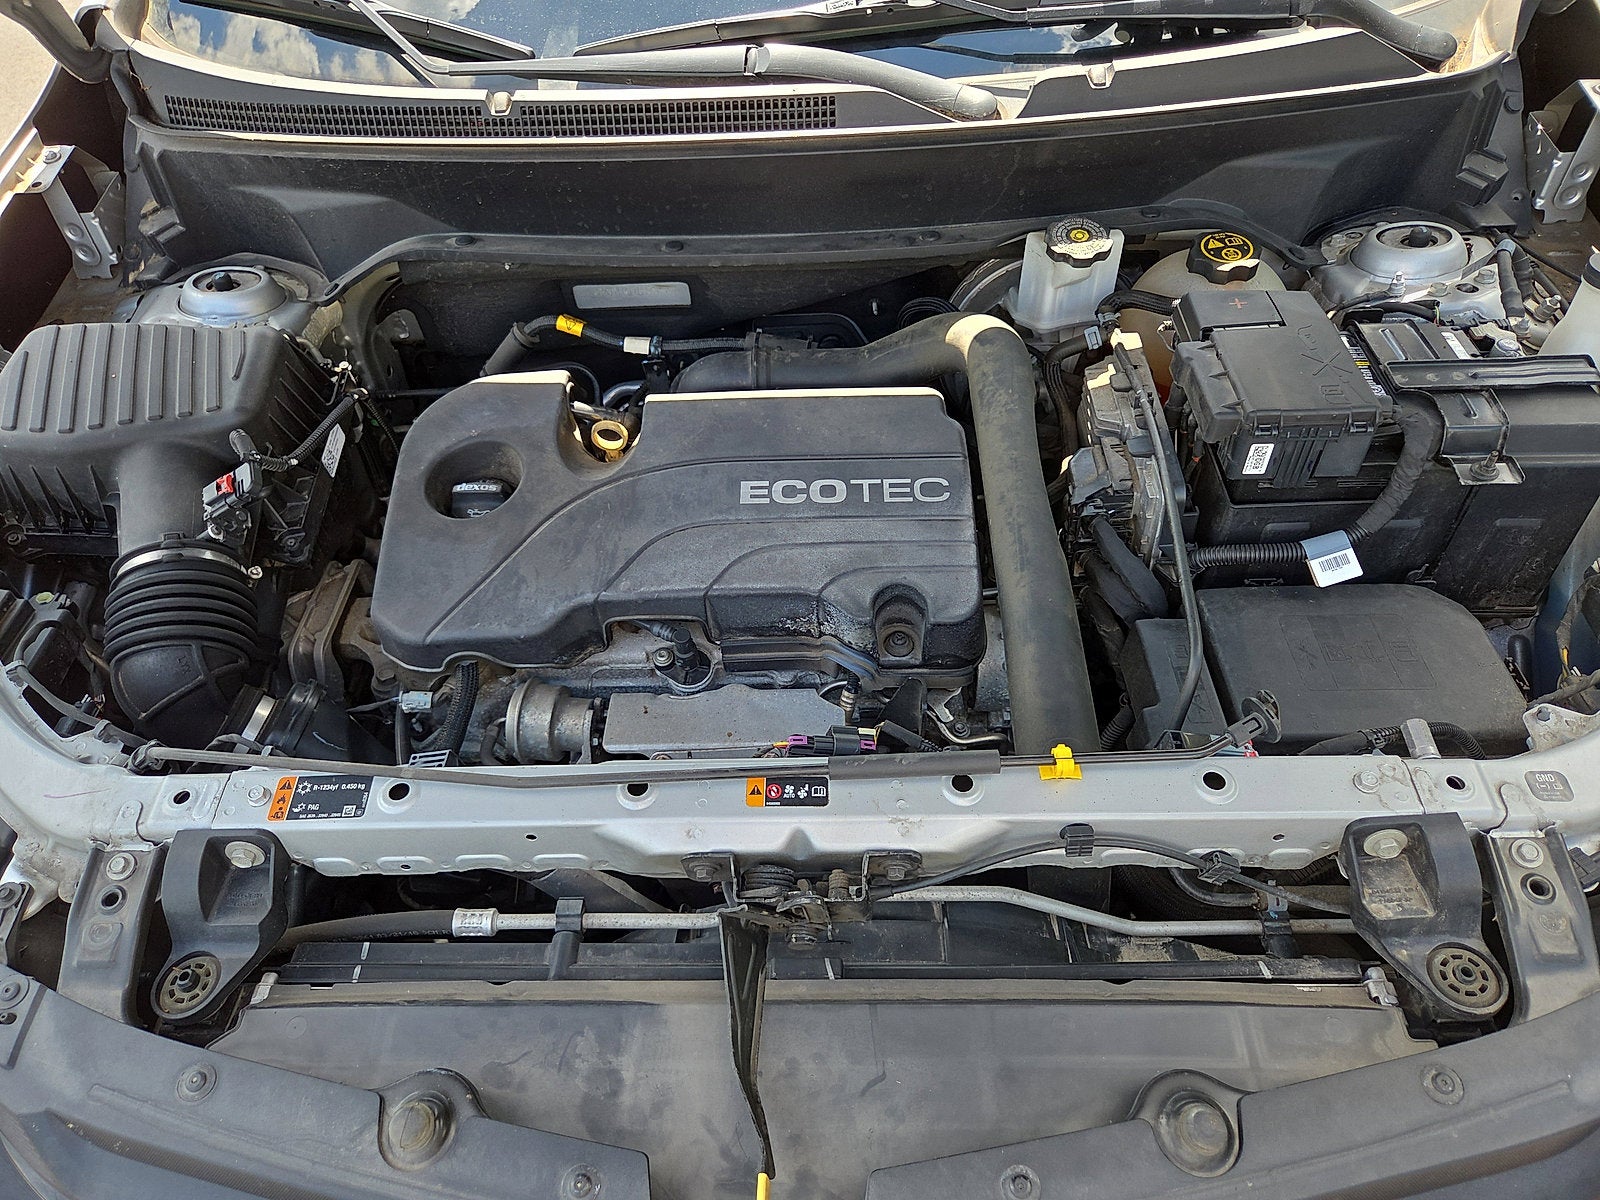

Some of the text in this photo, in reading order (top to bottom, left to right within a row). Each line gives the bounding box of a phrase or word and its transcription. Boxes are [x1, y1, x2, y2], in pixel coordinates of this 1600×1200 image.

[454, 482, 497, 491] dexos
[739, 477, 950, 504] ECOTEC
[1535, 773, 1555, 782] GND
